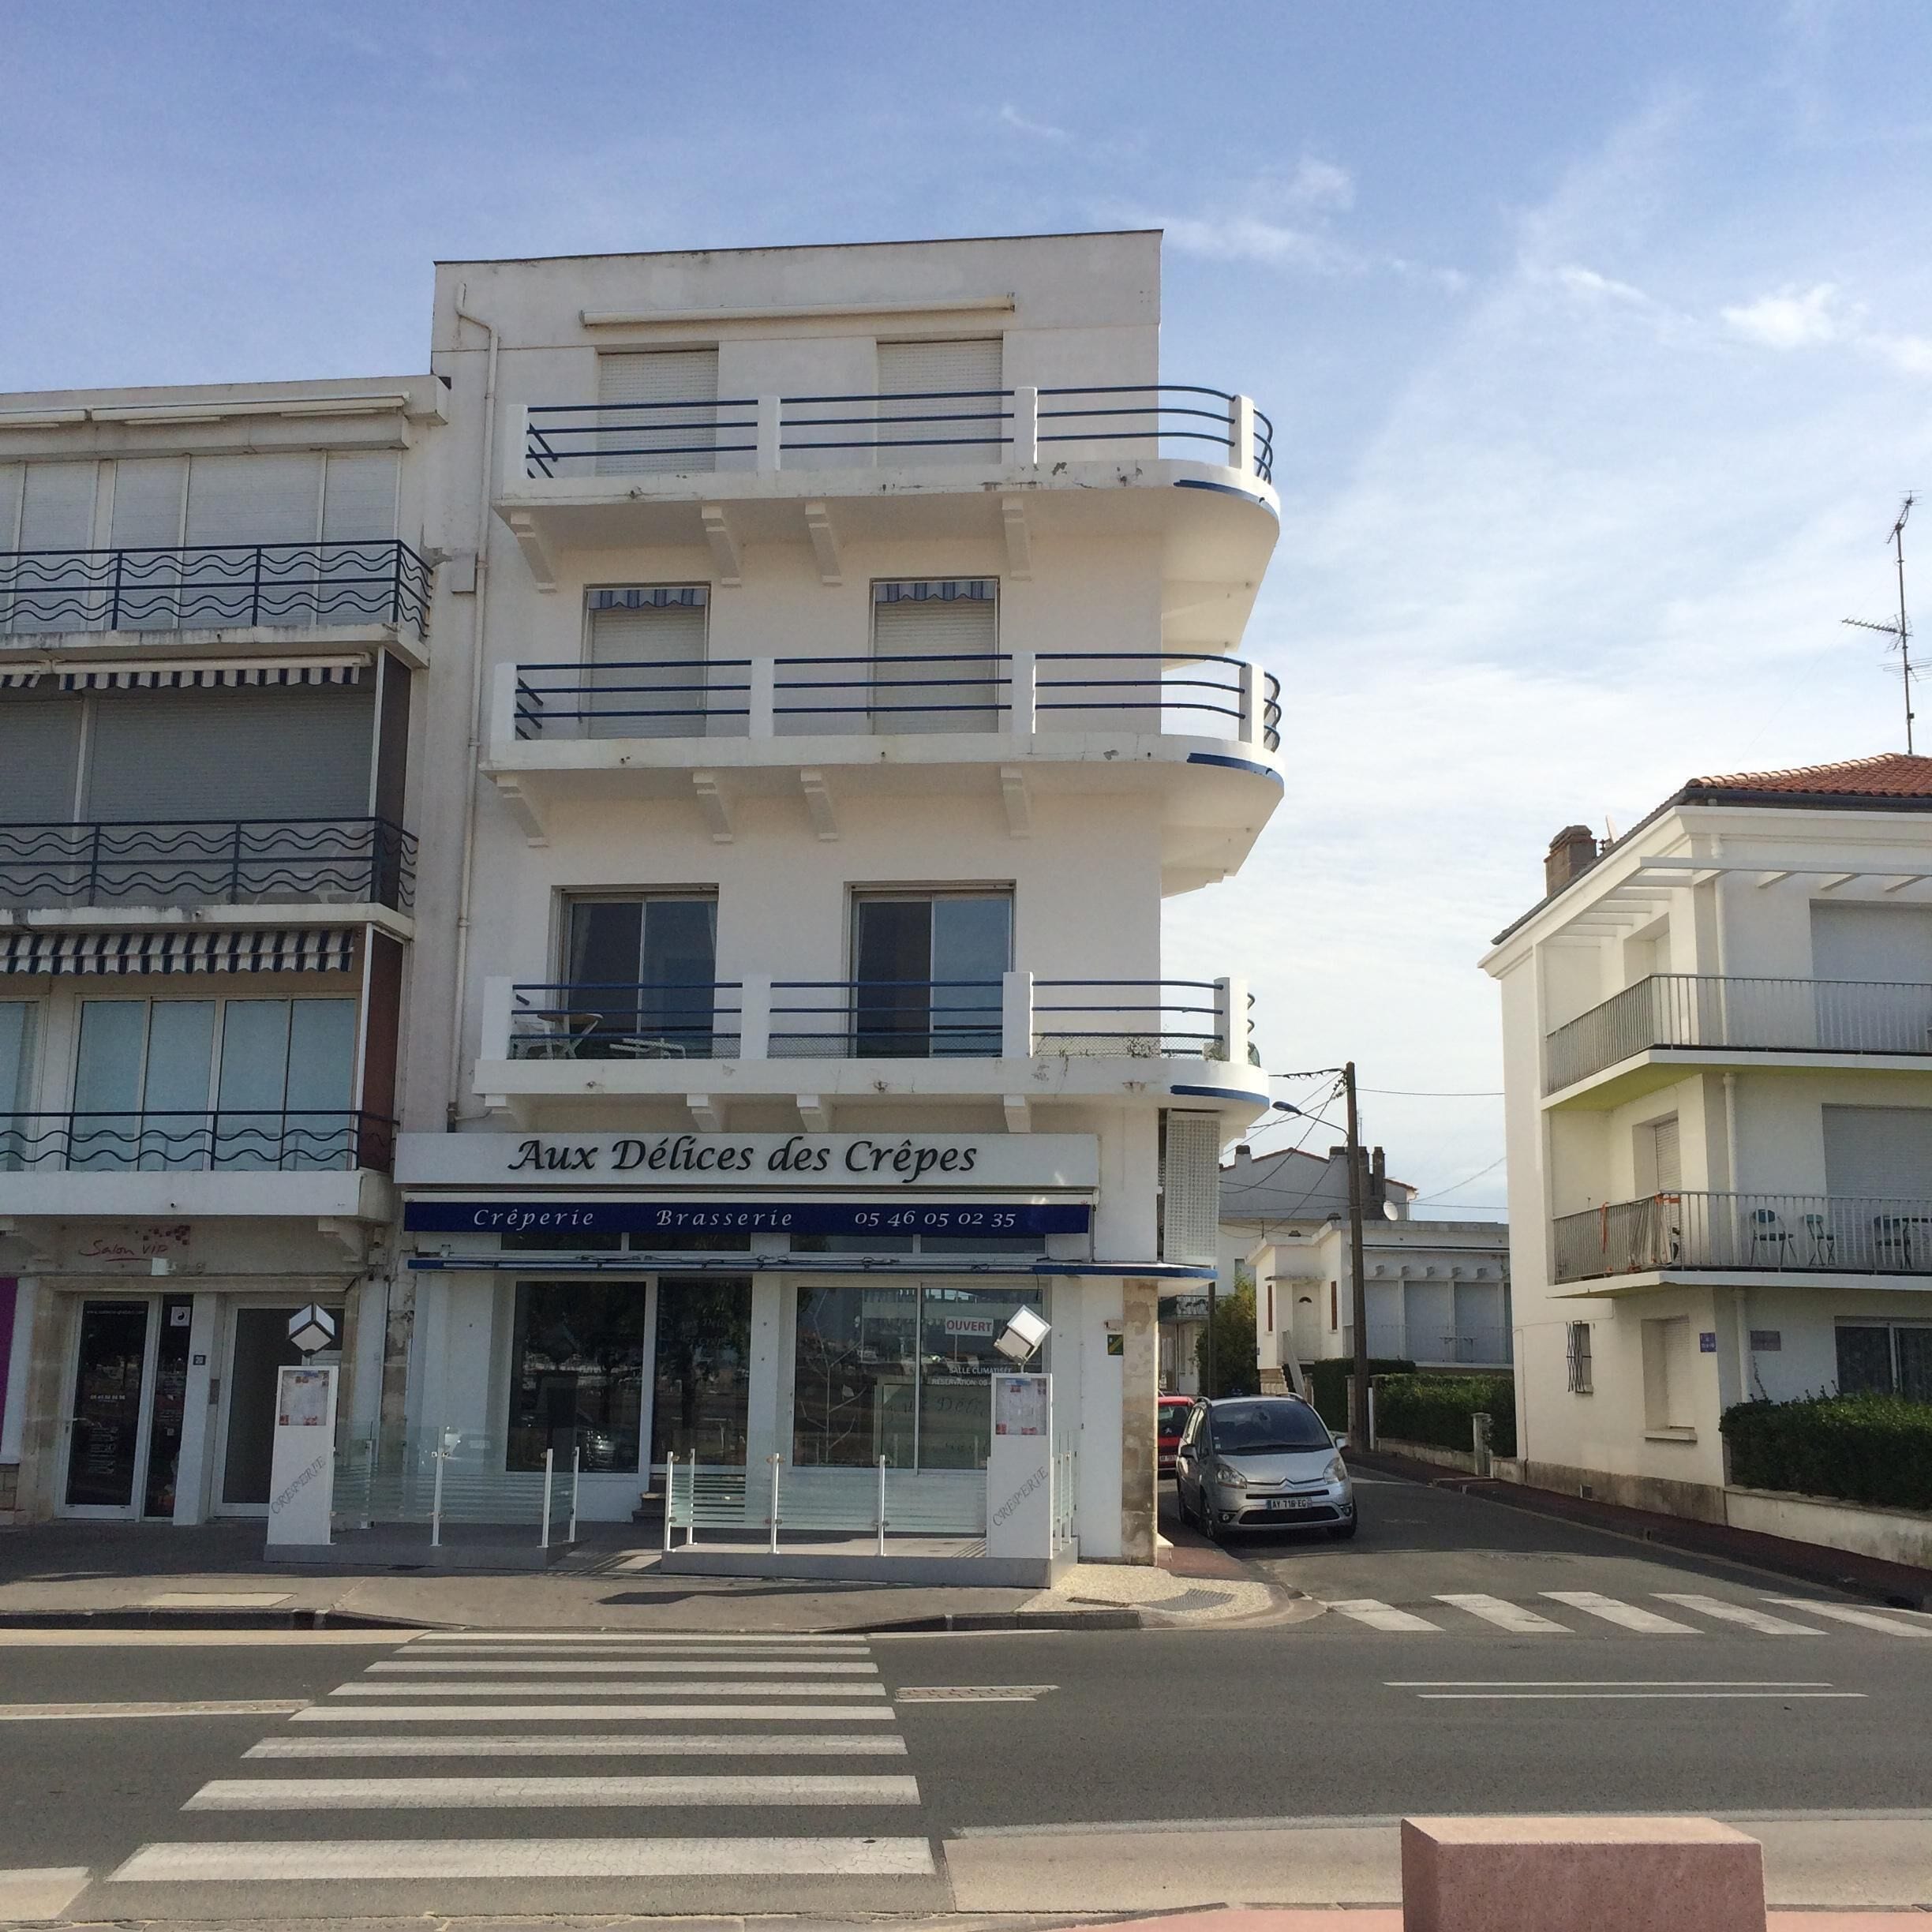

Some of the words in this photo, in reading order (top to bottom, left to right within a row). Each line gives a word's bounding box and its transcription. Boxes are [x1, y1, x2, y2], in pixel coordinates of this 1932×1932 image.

[507, 1139, 599, 1170] Aux
[611, 1135, 754, 1171] Délices
[767, 1136, 830, 1172] des
[844, 1138, 978, 1184] Crêpes
[473, 1208, 594, 1230] Crêperie
[656, 1209, 792, 1226] Brasserie
[855, 1212, 880, 1227] 05
[887, 1210, 915, 1227] 46
[924, 1212, 949, 1227] 05
[958, 1213, 983, 1225] 02
[990, 1213, 1016, 1227] 35
[79, 1239, 134, 1256] Salon
[142, 1243, 168, 1255] VIP
[946, 1319, 992, 1332] OUVERT
[271, 1455, 326, 1515] CREPERIE
[992, 1466, 1049, 1527] CREPERIE
